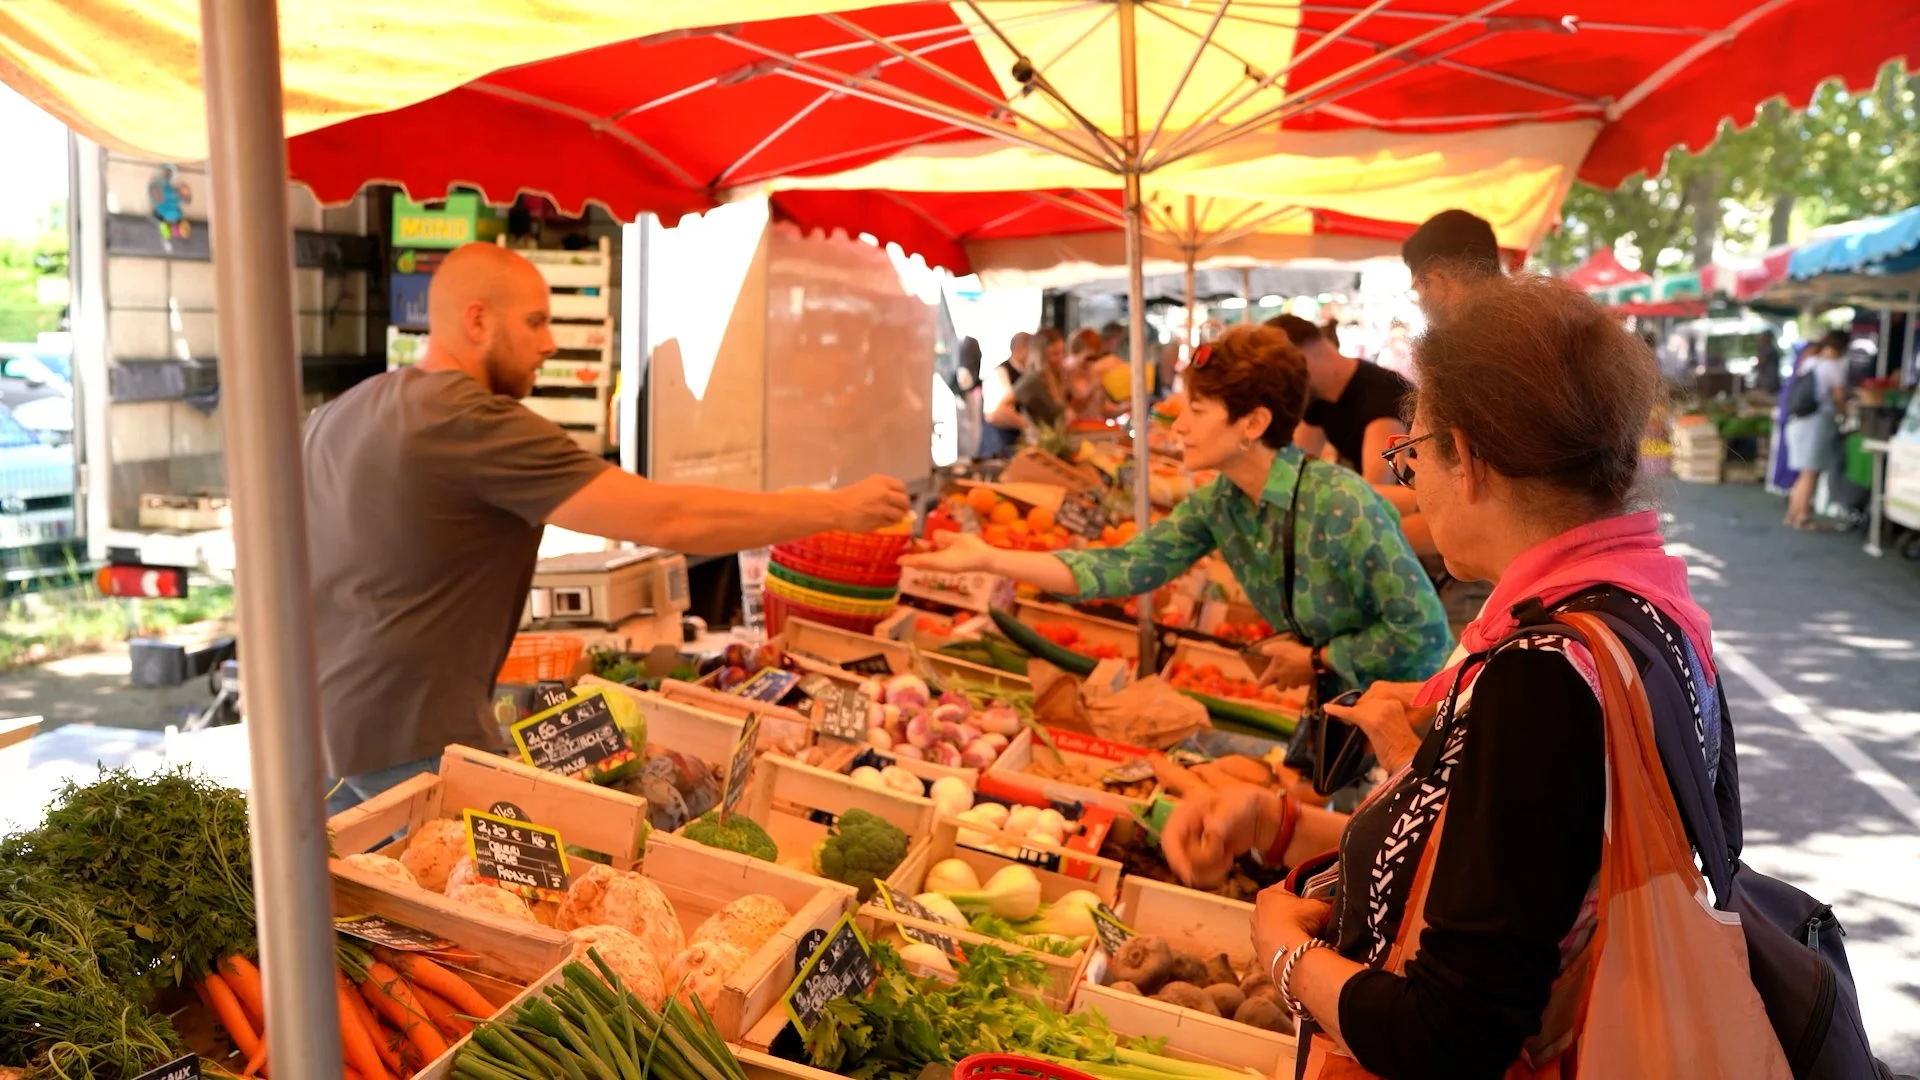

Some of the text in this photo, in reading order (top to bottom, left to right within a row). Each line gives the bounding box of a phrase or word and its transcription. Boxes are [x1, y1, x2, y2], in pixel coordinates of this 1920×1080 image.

[543, 691, 569, 707] 1kg
[493, 804, 517, 819] 1kg
[511, 829, 522, 841] €
